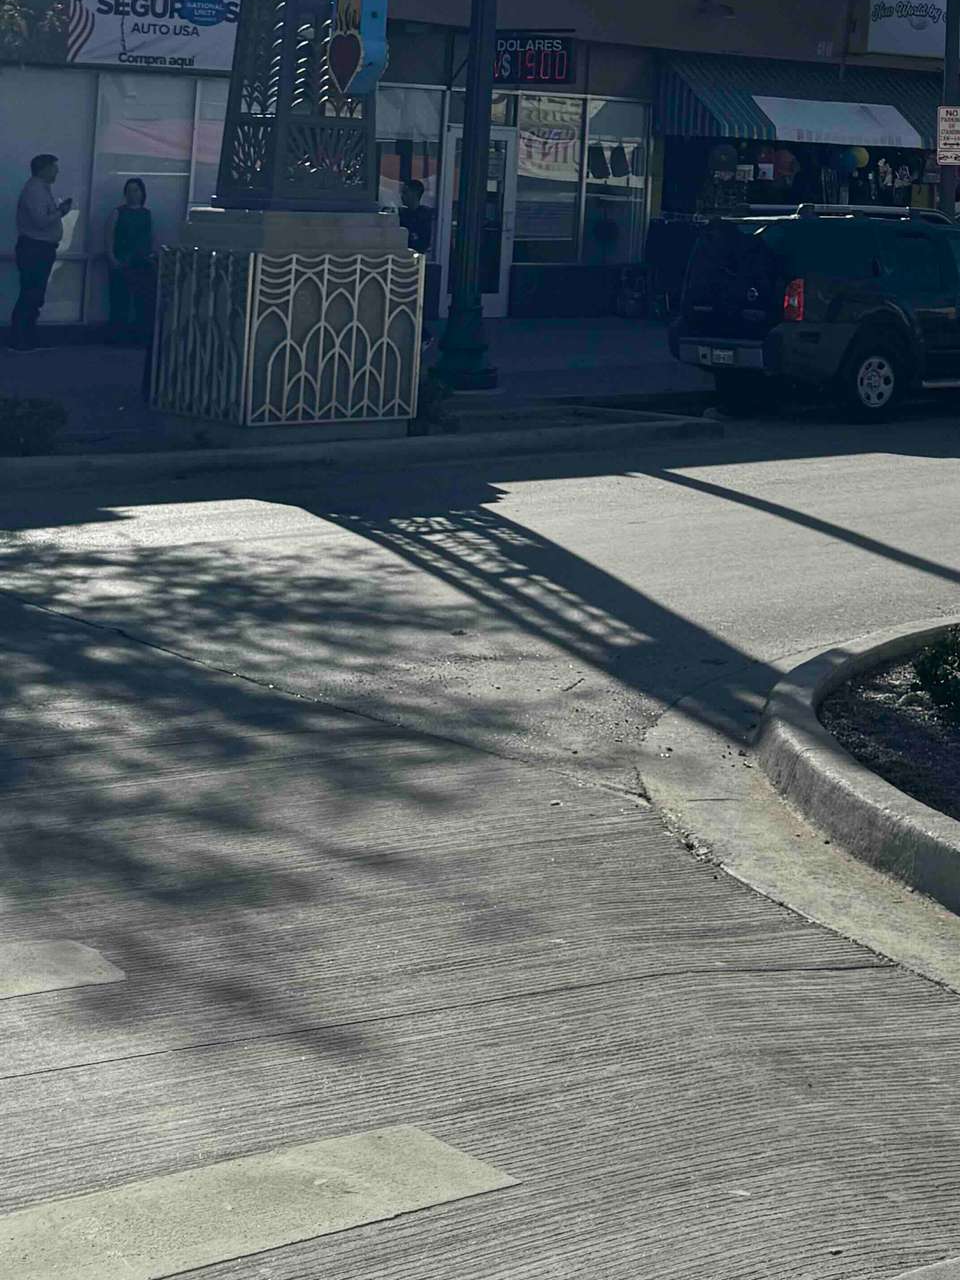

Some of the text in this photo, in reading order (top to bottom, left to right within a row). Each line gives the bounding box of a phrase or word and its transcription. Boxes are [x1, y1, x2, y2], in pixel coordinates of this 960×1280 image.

[131, 23, 201, 37] AUTO USA
[497, 39, 563, 52] DOLARES
[118, 52, 167, 67] Compra
[945, 109, 959, 117] NO
